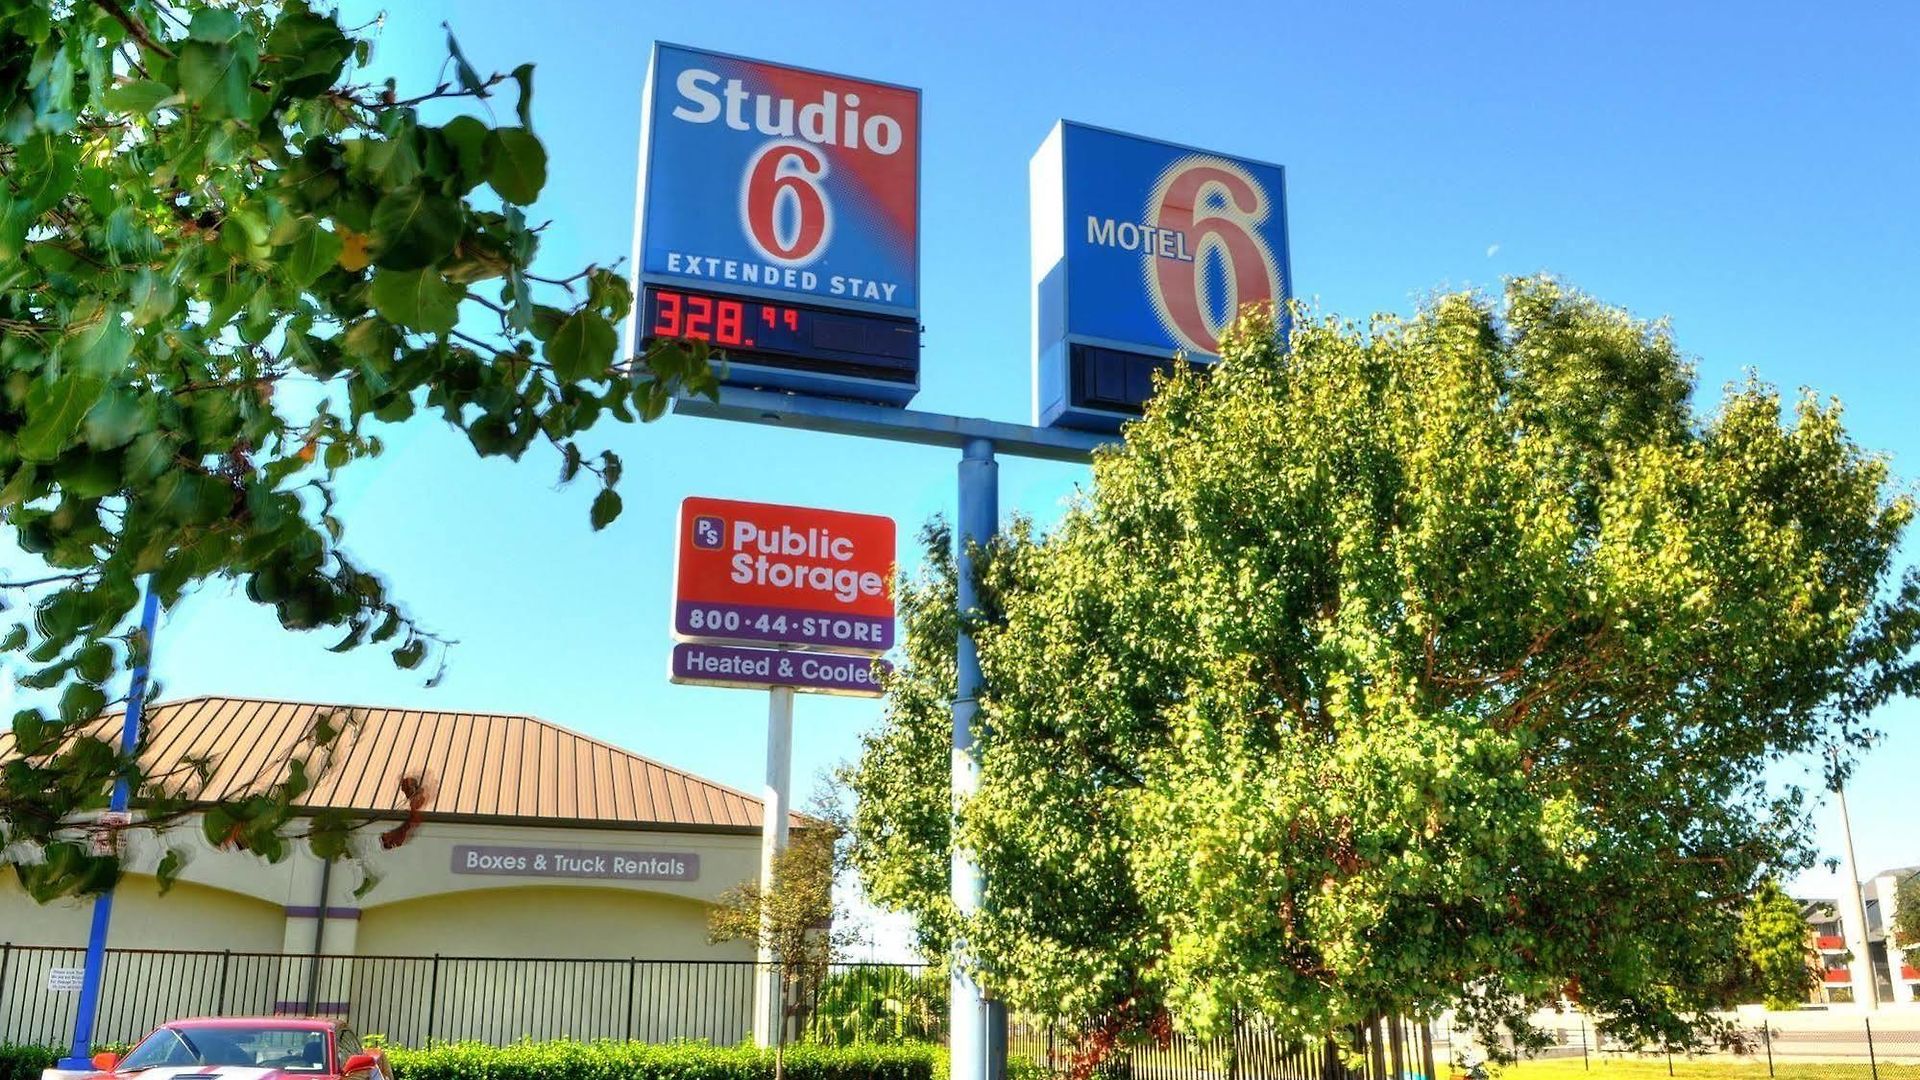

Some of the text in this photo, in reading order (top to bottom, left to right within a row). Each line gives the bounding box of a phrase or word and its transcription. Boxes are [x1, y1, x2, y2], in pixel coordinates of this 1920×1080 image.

[672, 68, 903, 156] Studio
[744, 140, 830, 266] 6
[667, 252, 898, 302] EXTENDED STAY
[1086, 158, 1276, 358] MOTEL 6
[733, 520, 854, 562] Public
[730, 553, 883, 604] Storage
[686, 650, 770, 676] Heated
[777, 657, 794, 678] &
[466, 851, 686, 876] Boxes & Truck Rentals
